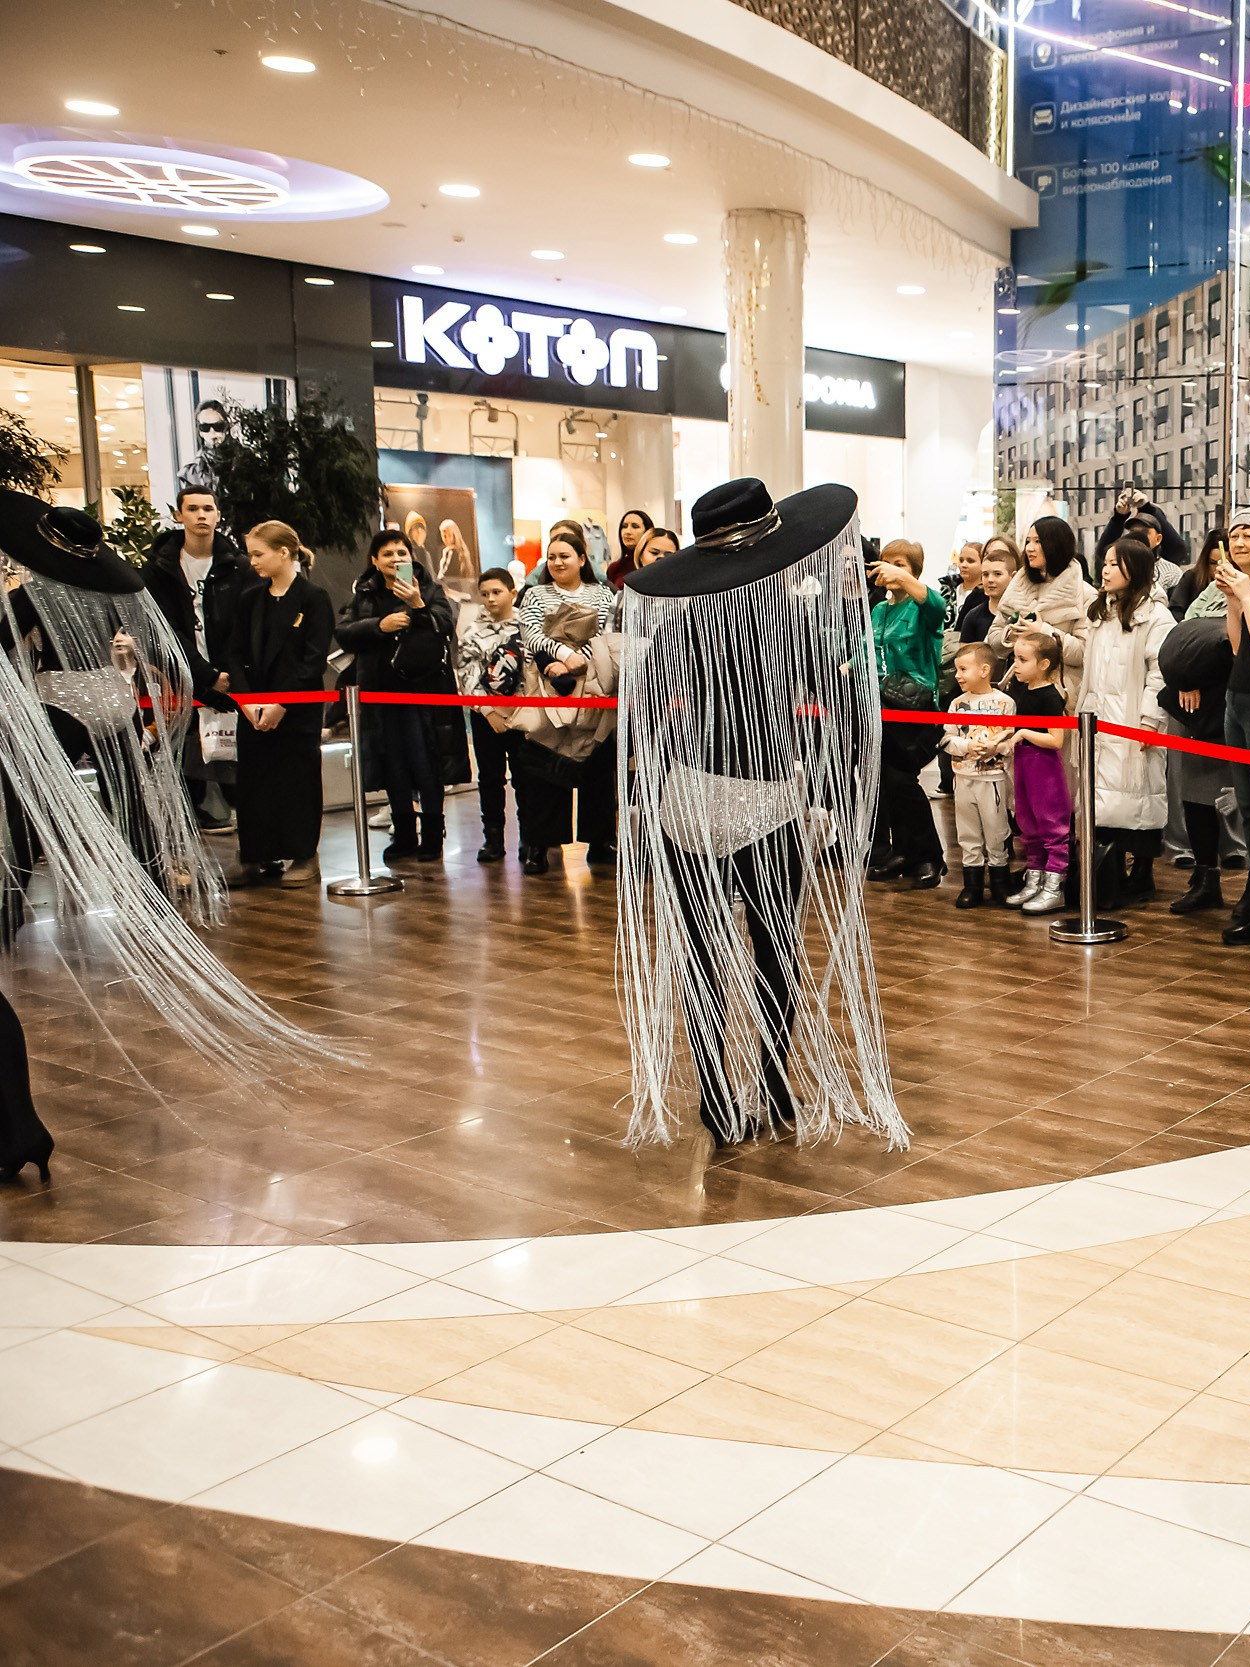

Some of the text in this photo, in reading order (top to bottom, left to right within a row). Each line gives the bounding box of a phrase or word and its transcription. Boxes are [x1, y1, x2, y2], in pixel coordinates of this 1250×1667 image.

[1062, 159, 1159, 179] Более 100 камер
[1062, 173, 1173, 195] видеонаблюдения
